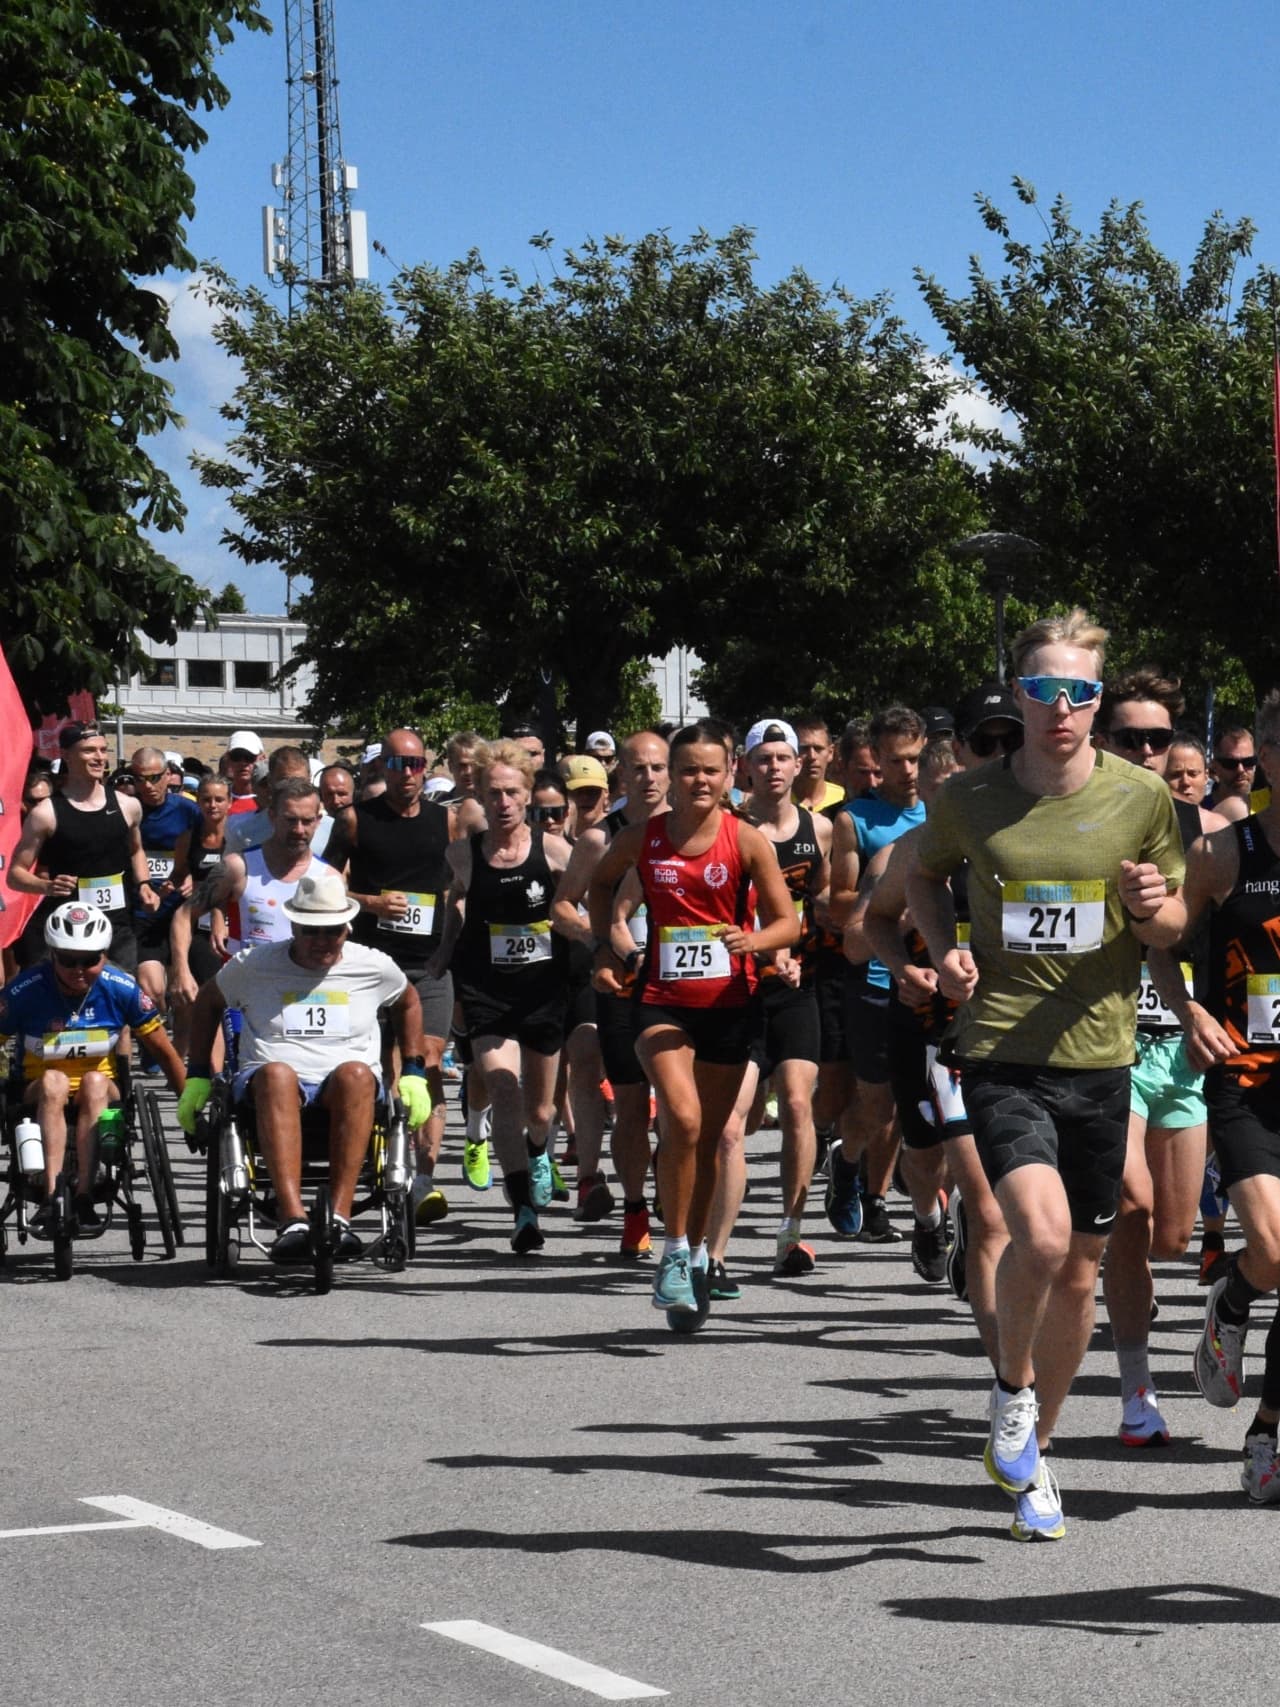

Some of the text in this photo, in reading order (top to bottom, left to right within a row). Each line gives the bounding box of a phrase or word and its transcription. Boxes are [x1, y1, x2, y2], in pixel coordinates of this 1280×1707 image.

[984, 695, 1001, 704] NB
[96, 888, 112, 904] 33
[1029, 907, 1076, 938] 271
[506, 938, 535, 955] 249
[676, 945, 711, 967] 275
[306, 1007, 326, 1026] 13
[65, 1046, 87, 1059] 45
